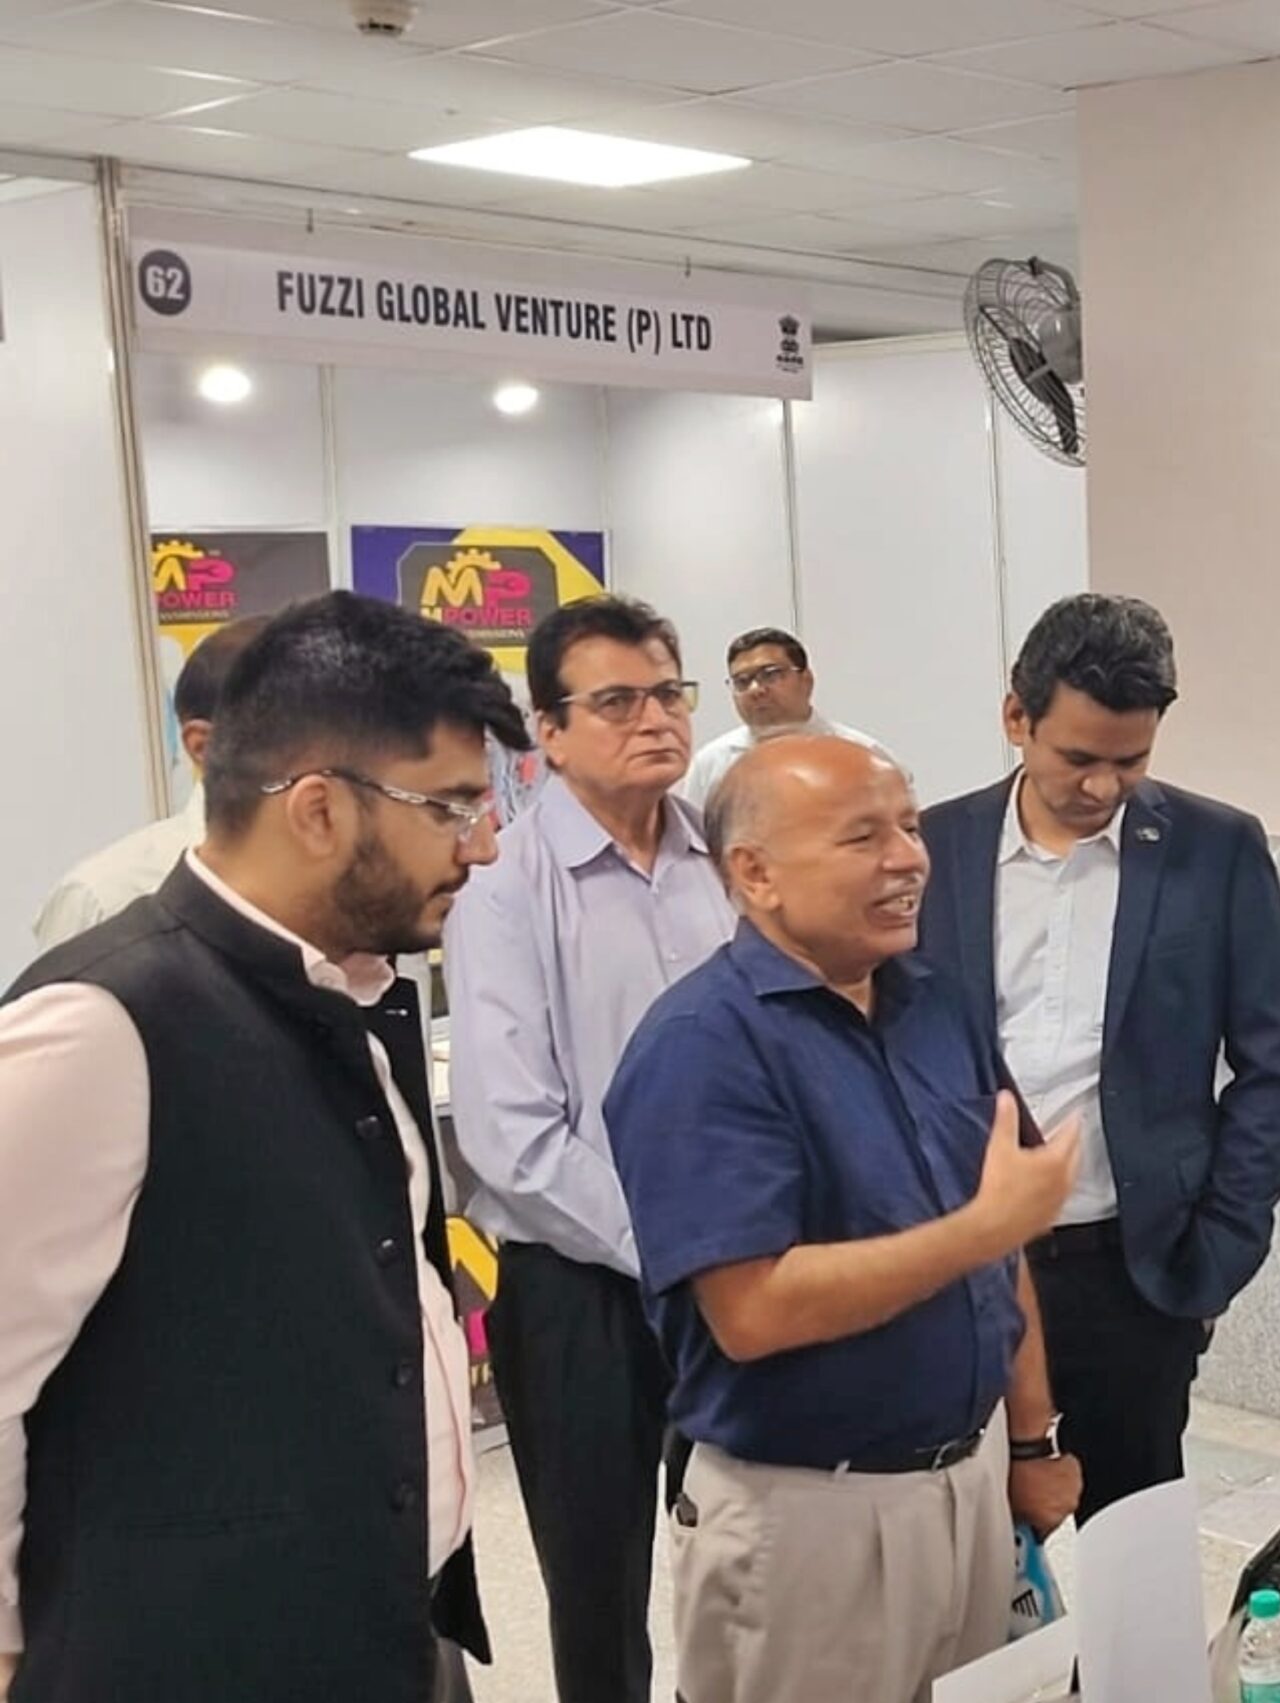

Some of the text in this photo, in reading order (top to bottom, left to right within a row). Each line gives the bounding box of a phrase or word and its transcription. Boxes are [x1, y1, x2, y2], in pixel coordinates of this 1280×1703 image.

[145, 265, 184, 299] 62
[276, 270, 711, 355] FUZZI GLOBAL VENTURE (P) LTD
